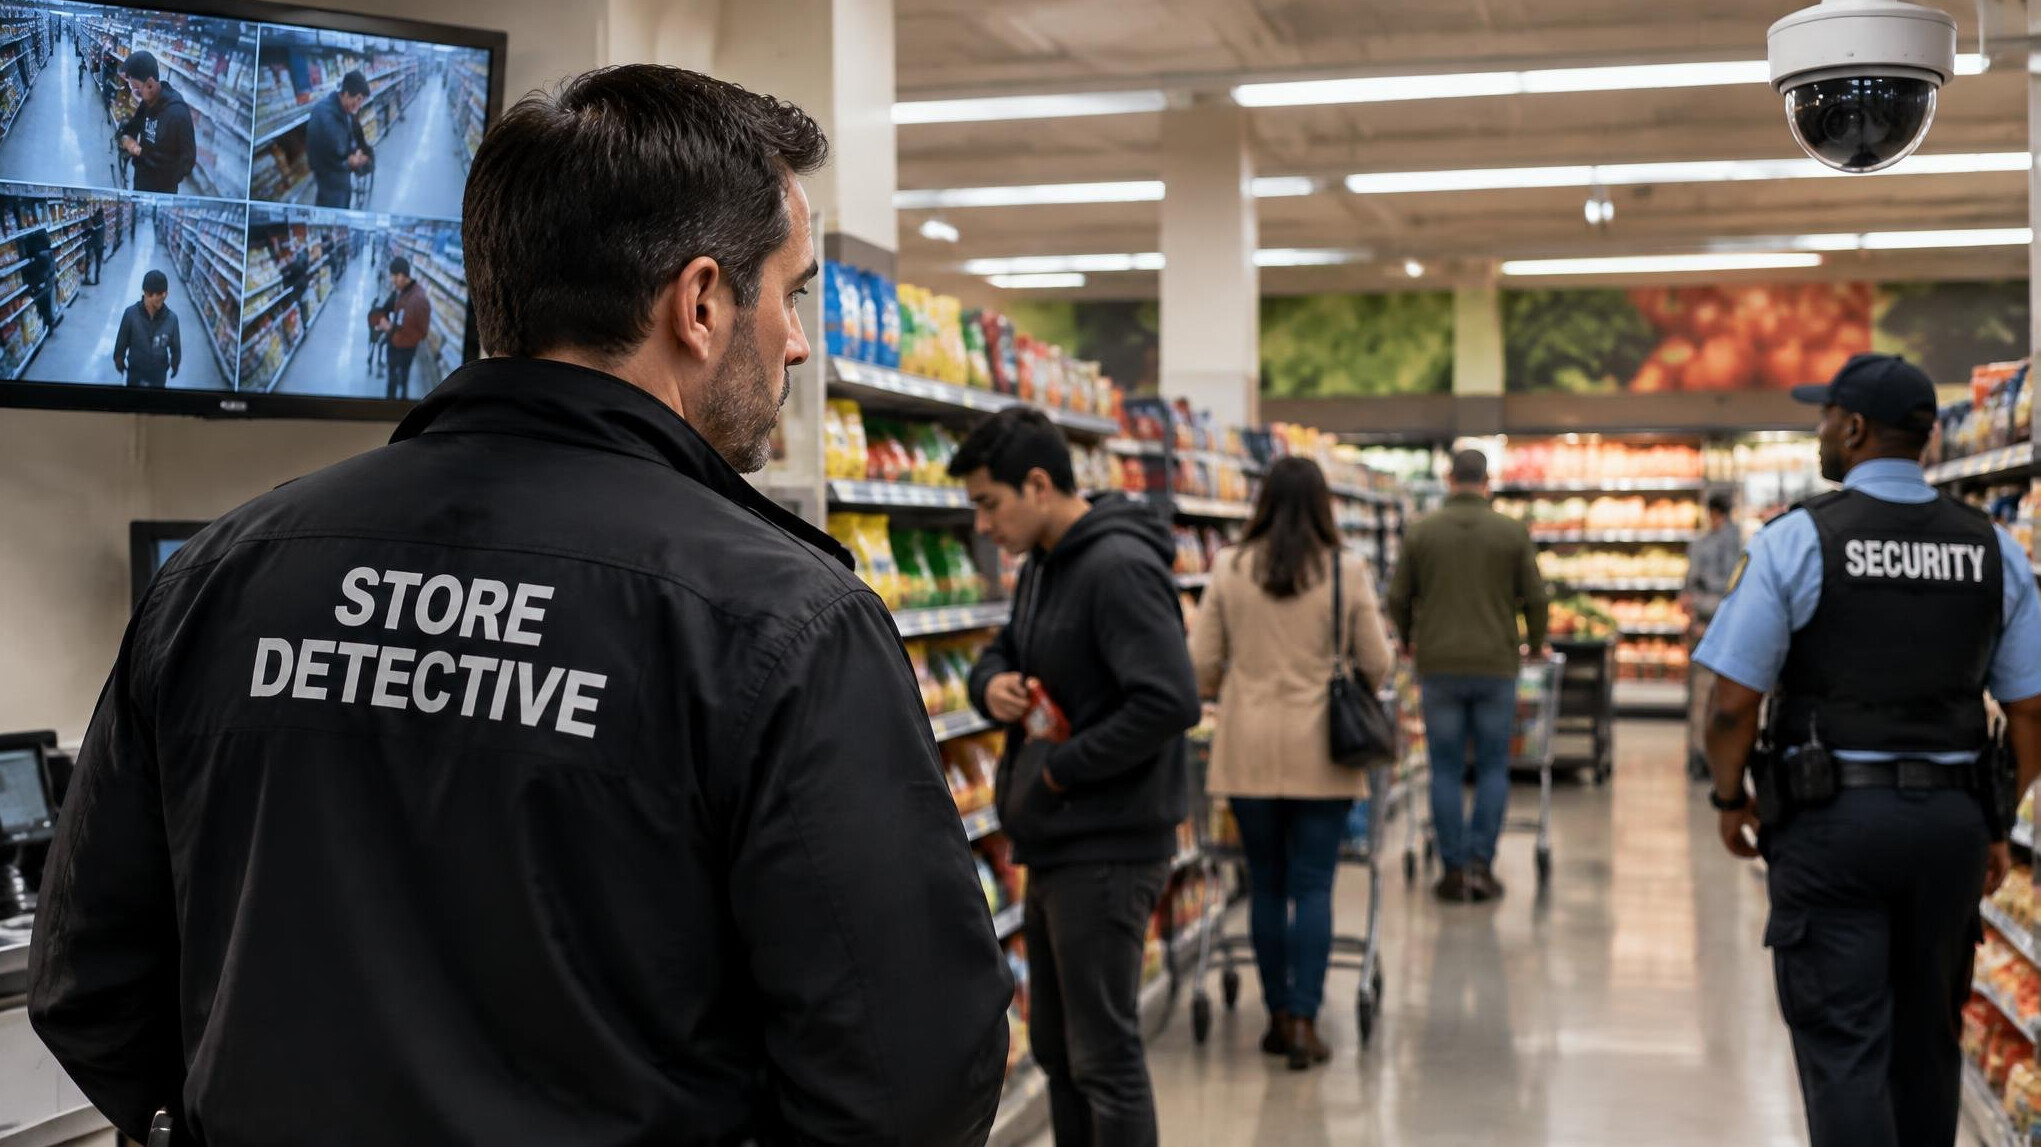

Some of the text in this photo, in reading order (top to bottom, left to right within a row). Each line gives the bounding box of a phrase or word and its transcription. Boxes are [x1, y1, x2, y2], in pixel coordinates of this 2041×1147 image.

[1845, 539, 1986, 582] SECURITY
[334, 566, 555, 647] STORE
[250, 637, 608, 739] DETECTIVE
